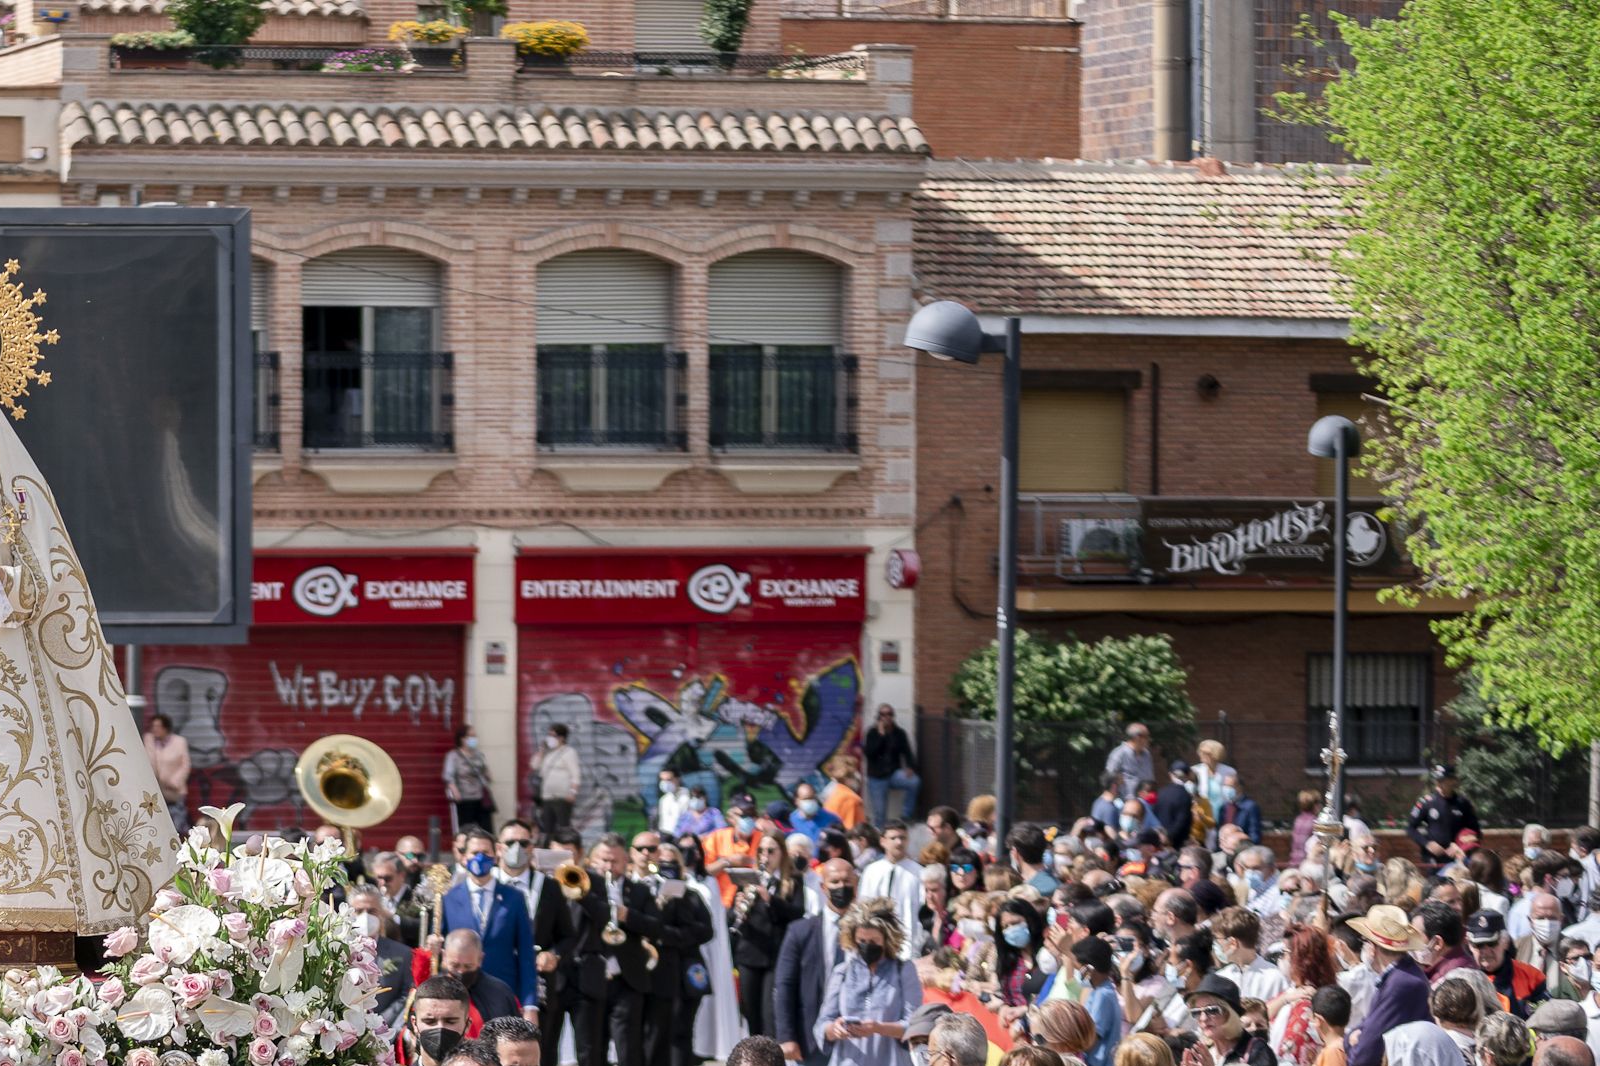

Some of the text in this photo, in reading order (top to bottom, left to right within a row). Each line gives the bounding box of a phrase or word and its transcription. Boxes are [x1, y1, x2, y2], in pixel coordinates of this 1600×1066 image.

[1162, 501, 1331, 575] BIRDHOUSE
[364, 580, 468, 600] EXCHANGE
[521, 579, 678, 599] ENTERTAINMENT
[759, 578, 859, 598] EXCHANGE
